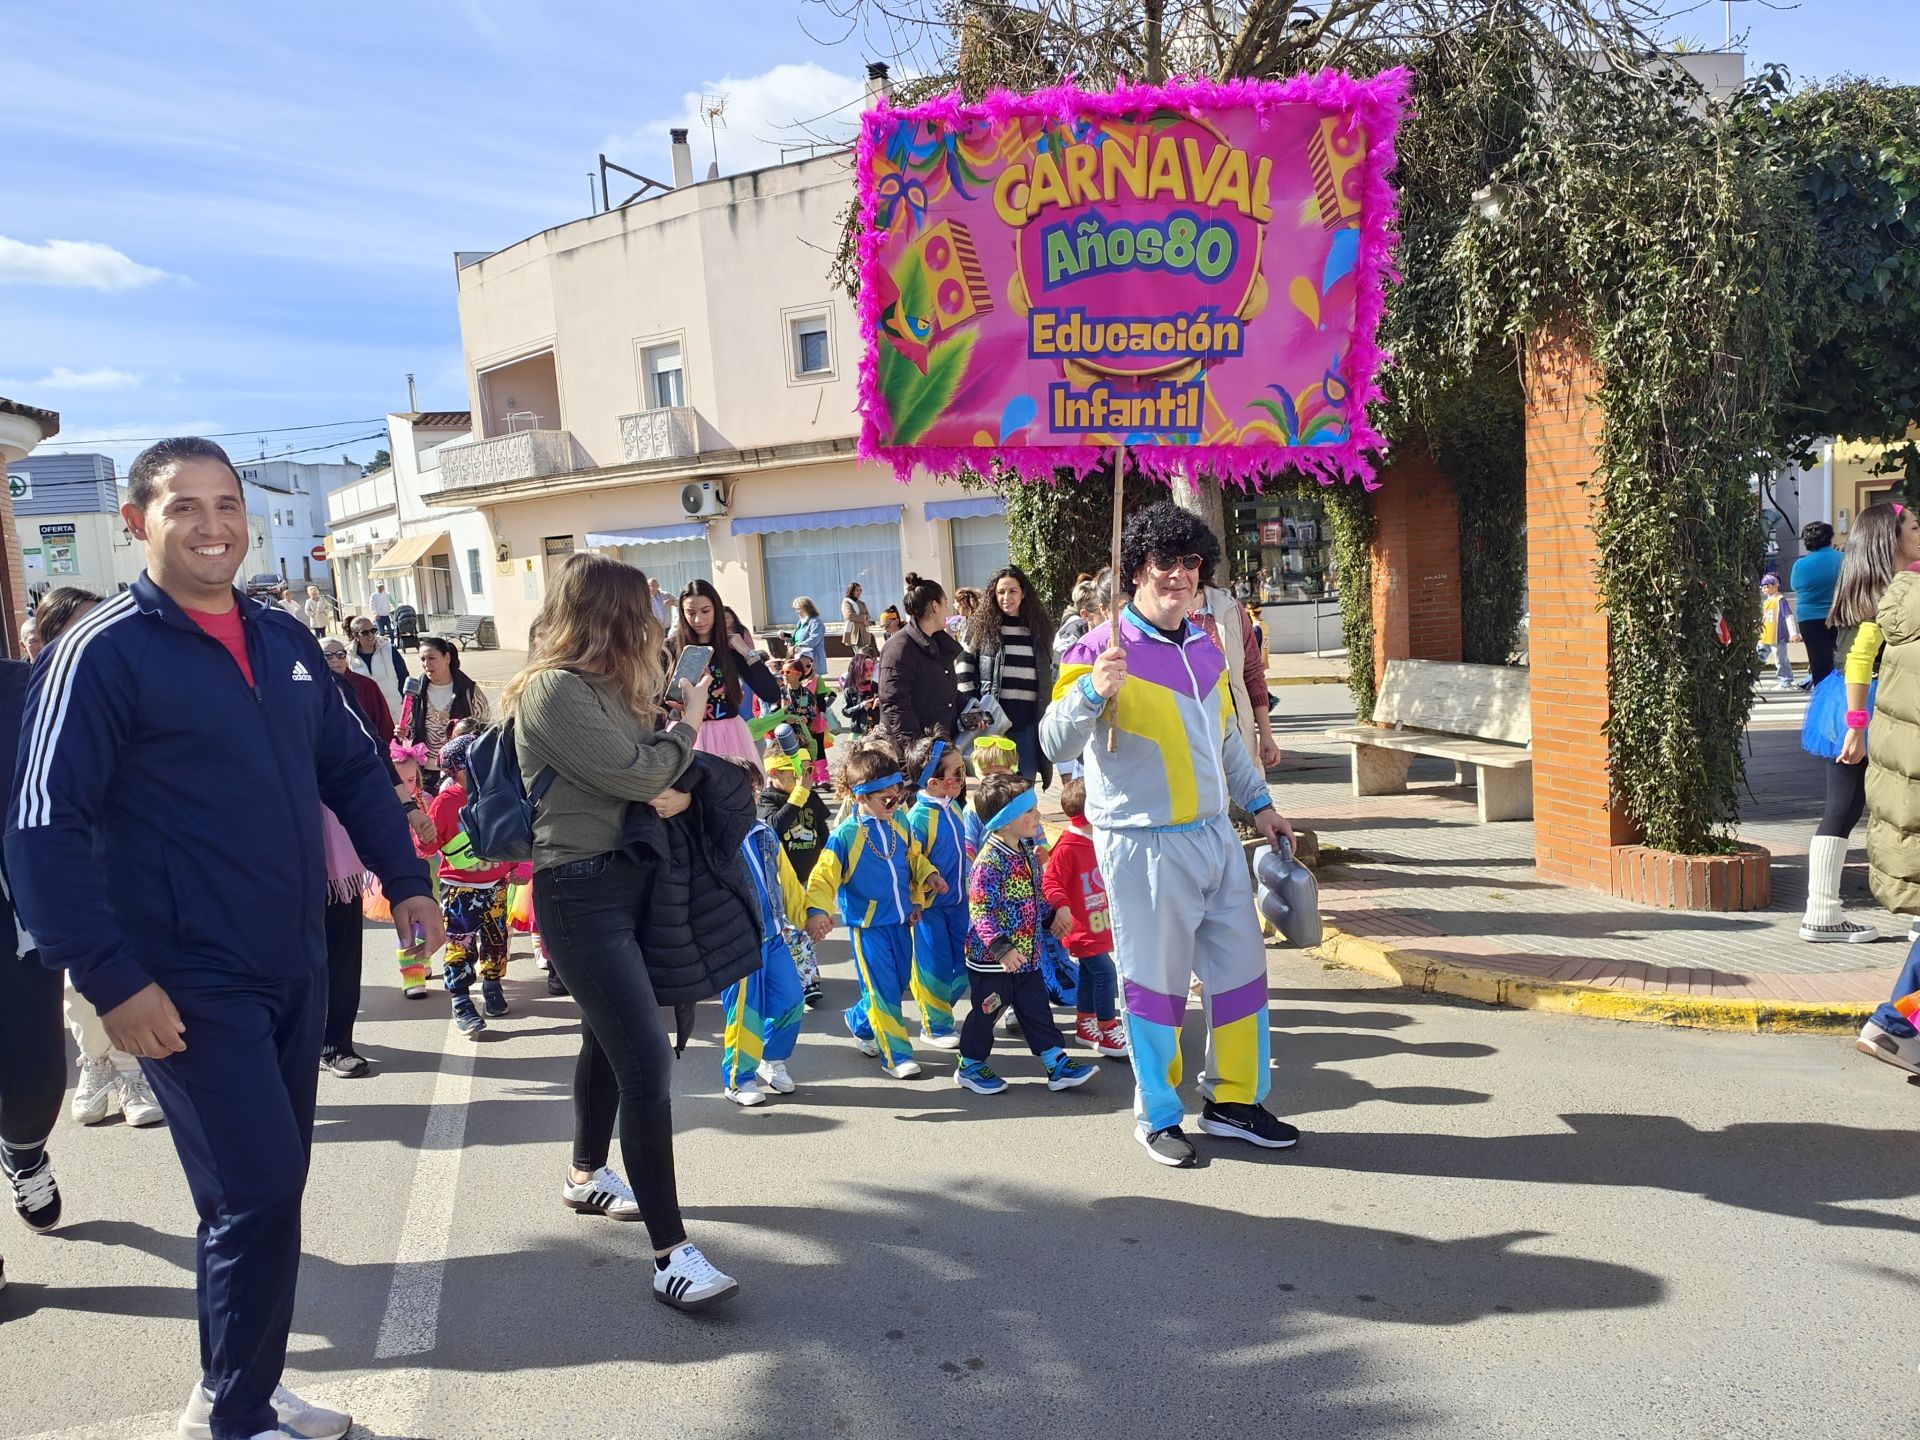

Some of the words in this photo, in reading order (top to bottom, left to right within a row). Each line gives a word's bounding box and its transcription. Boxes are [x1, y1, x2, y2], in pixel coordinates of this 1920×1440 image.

[993, 135, 1273, 227] CARNAVAL
[1033, 312, 1240, 354] Educación
[1054, 386, 1200, 428] Infantil
[40, 525, 74, 534] OFERTA
